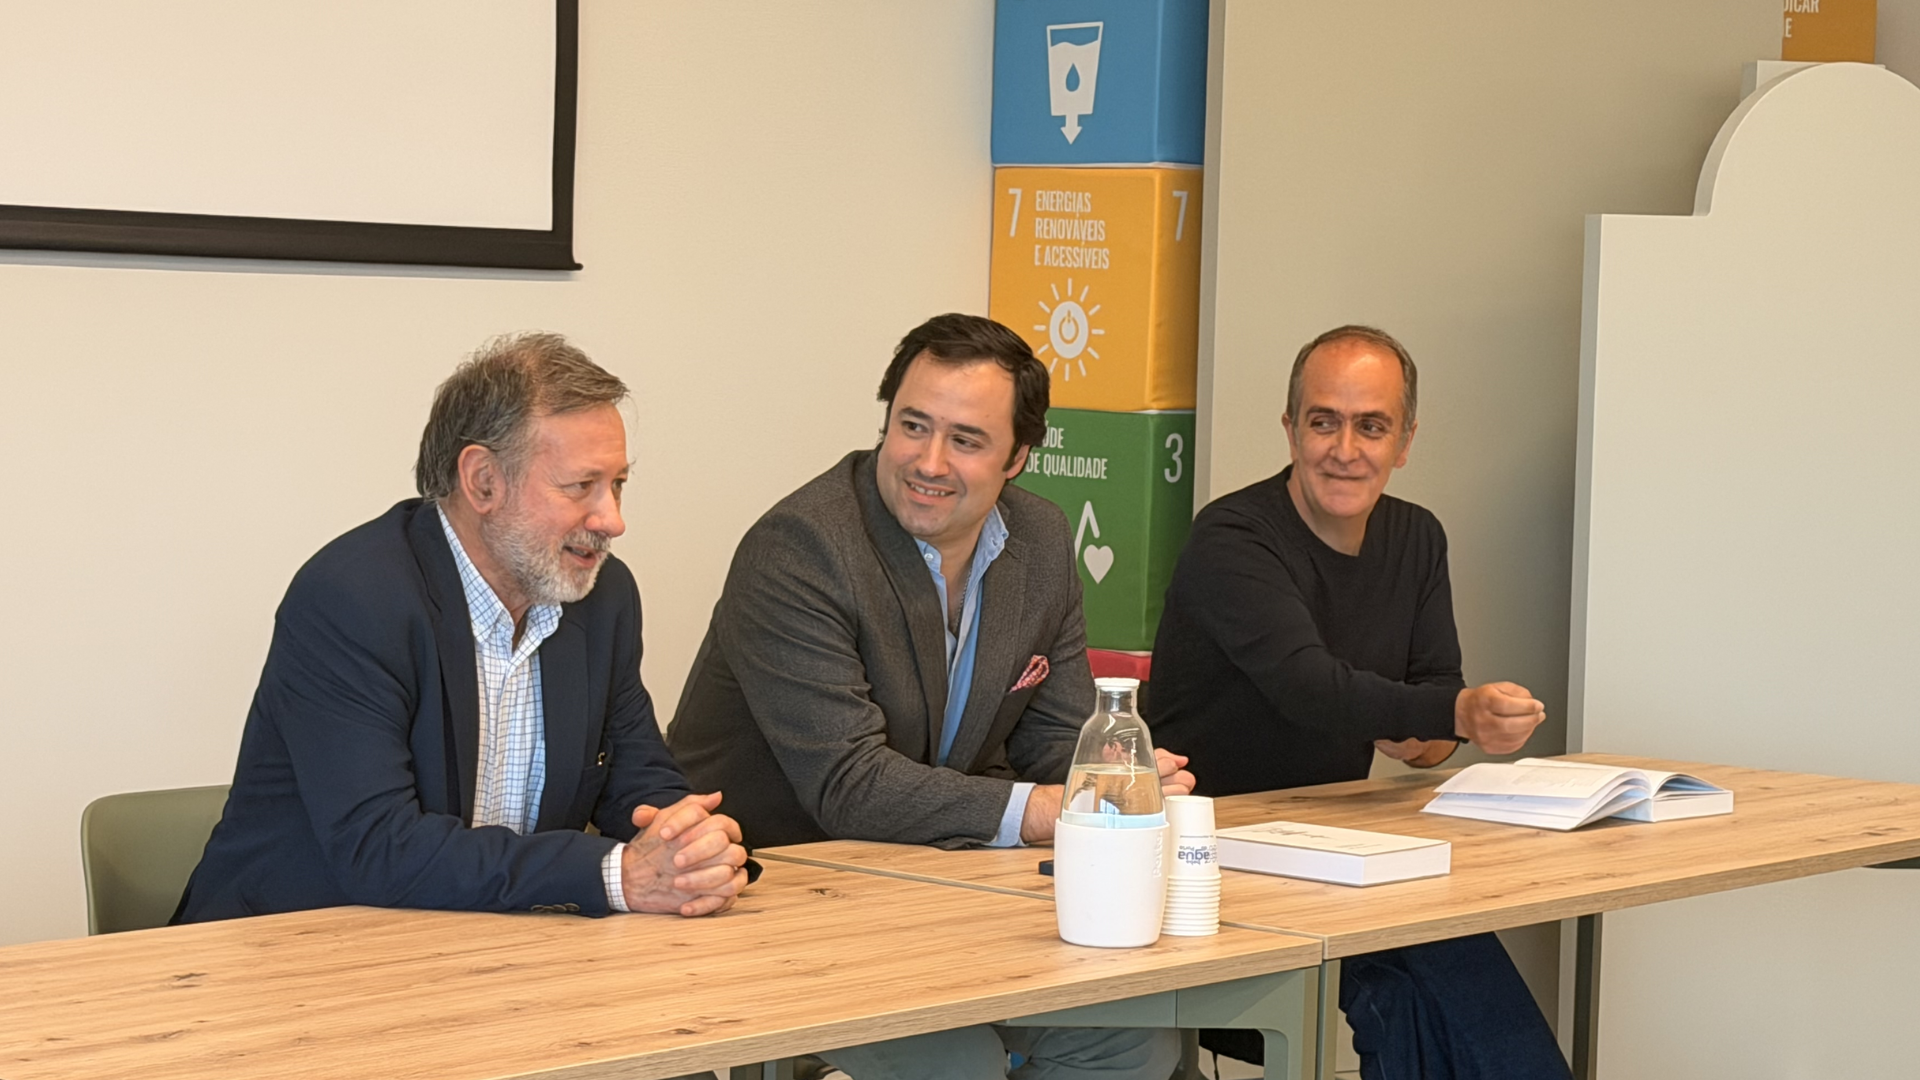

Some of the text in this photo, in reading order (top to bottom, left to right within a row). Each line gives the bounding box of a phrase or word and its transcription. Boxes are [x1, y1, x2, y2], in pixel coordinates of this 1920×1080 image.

[1008, 188, 1022, 238] 7
[1035, 190, 1091, 213] ENERGIAS
[1172, 190, 1188, 241] 7
[1035, 212, 1105, 242] RENOVÁVEIS
[1034, 241, 1109, 270] E ACESSÍVEIS
[1042, 420, 1064, 449] ÚDE
[1043, 453, 1108, 479] QUALIDADE
[1164, 433, 1183, 483] 3
